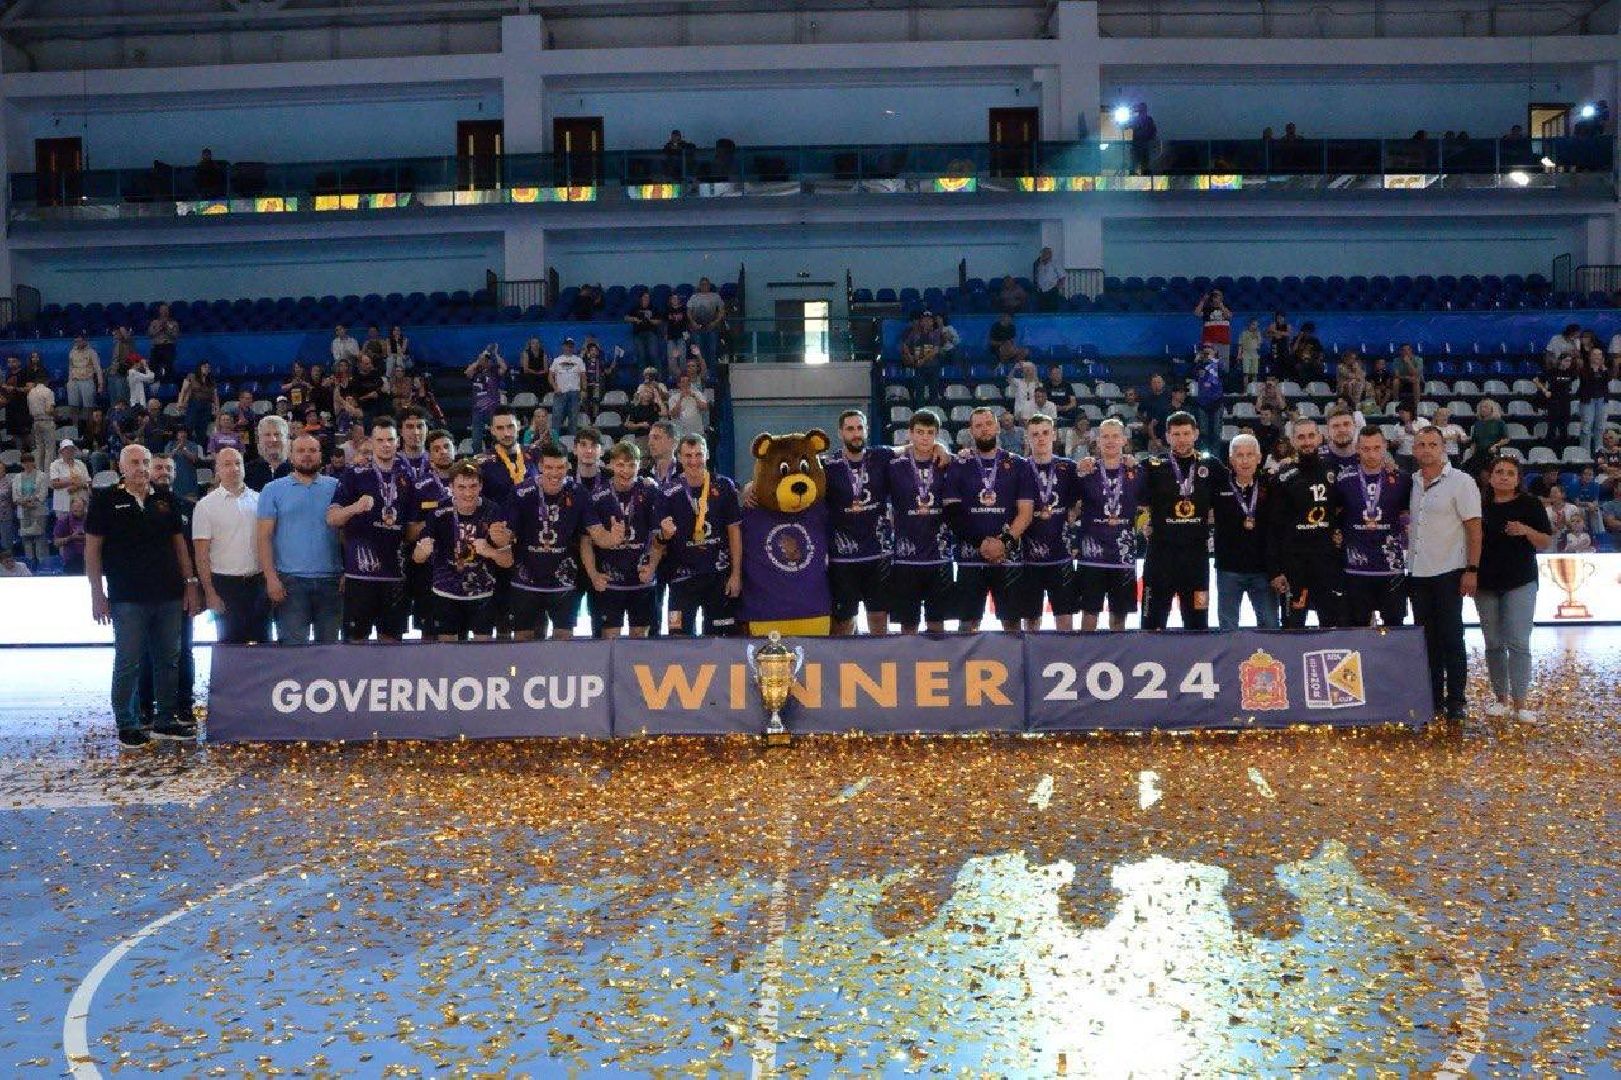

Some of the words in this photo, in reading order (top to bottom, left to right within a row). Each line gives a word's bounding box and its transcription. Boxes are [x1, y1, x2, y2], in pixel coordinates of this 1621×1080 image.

[1309, 483, 1328, 502] 12
[271, 676, 512, 713] GOVERNOR
[522, 675, 604, 710] CUP
[634, 659, 1014, 710] WINNER
[1041, 661, 1220, 701] 2024
